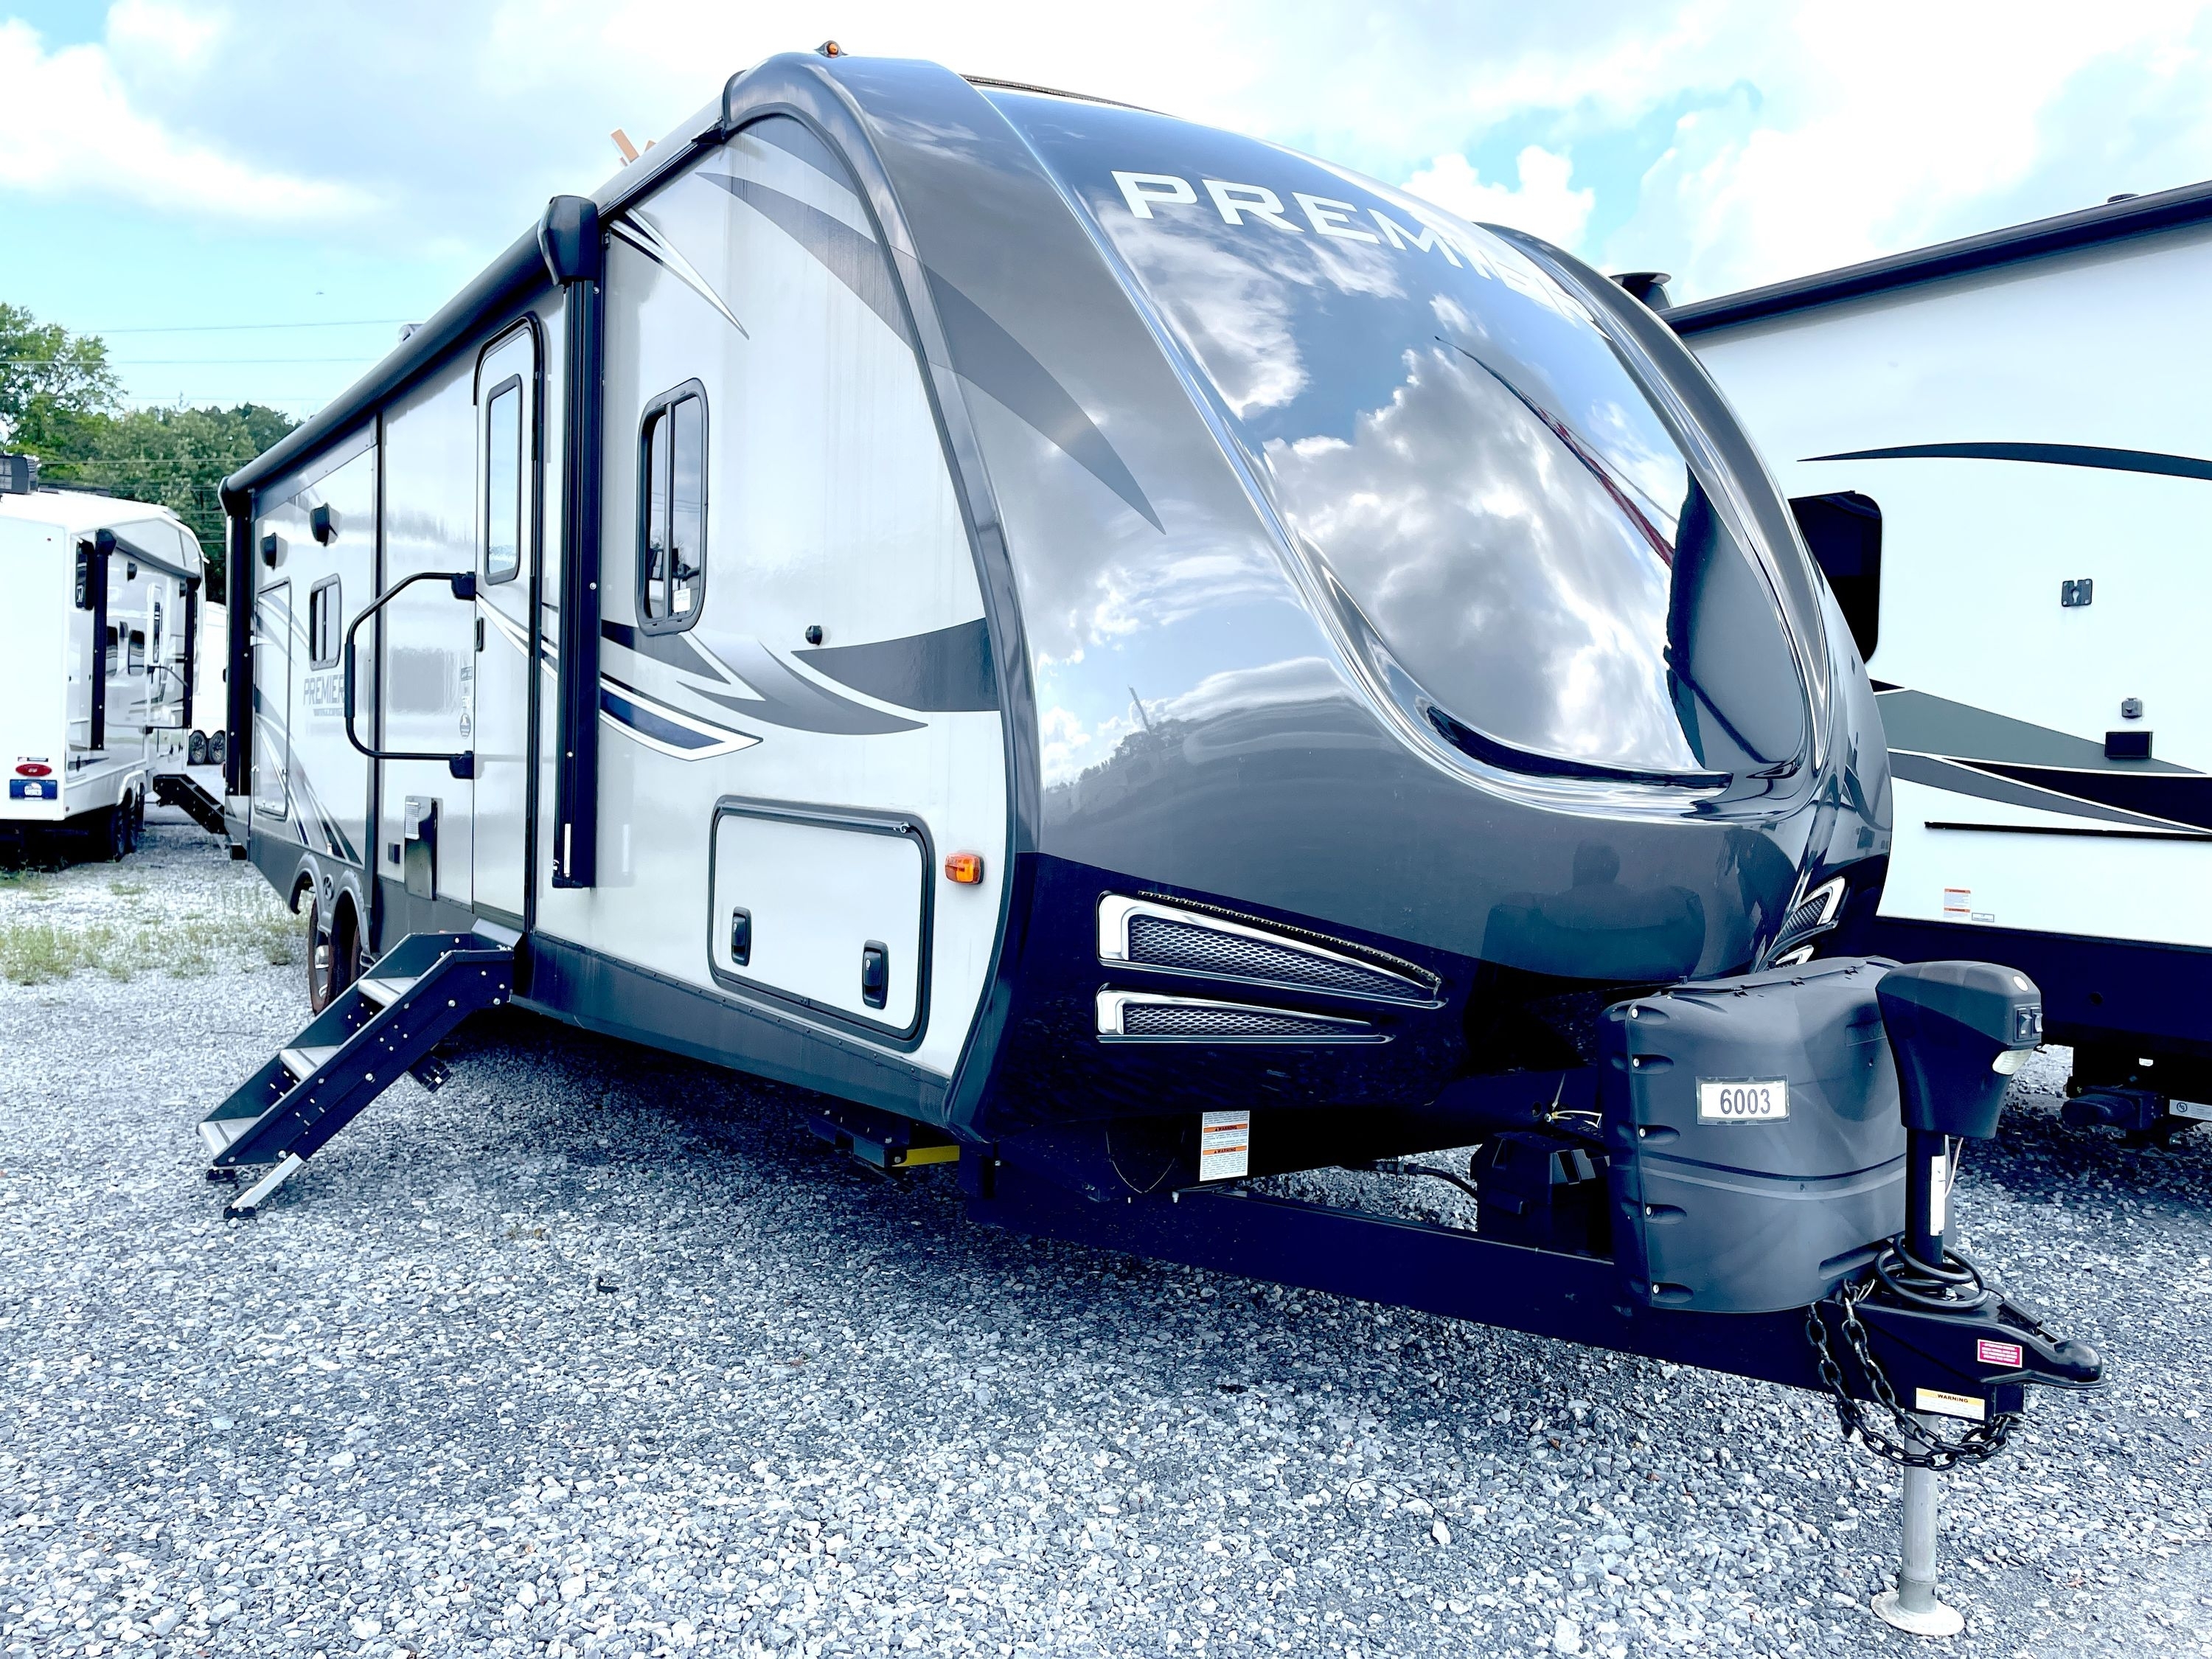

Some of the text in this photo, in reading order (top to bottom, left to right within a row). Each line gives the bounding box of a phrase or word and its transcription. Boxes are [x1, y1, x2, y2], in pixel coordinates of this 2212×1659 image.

[1110, 170, 1613, 341] PREMIER
[303, 674, 344, 706] PREMIER
[1720, 1088, 1770, 1115] 6003
[1938, 1394, 1969, 1403] WARNING
